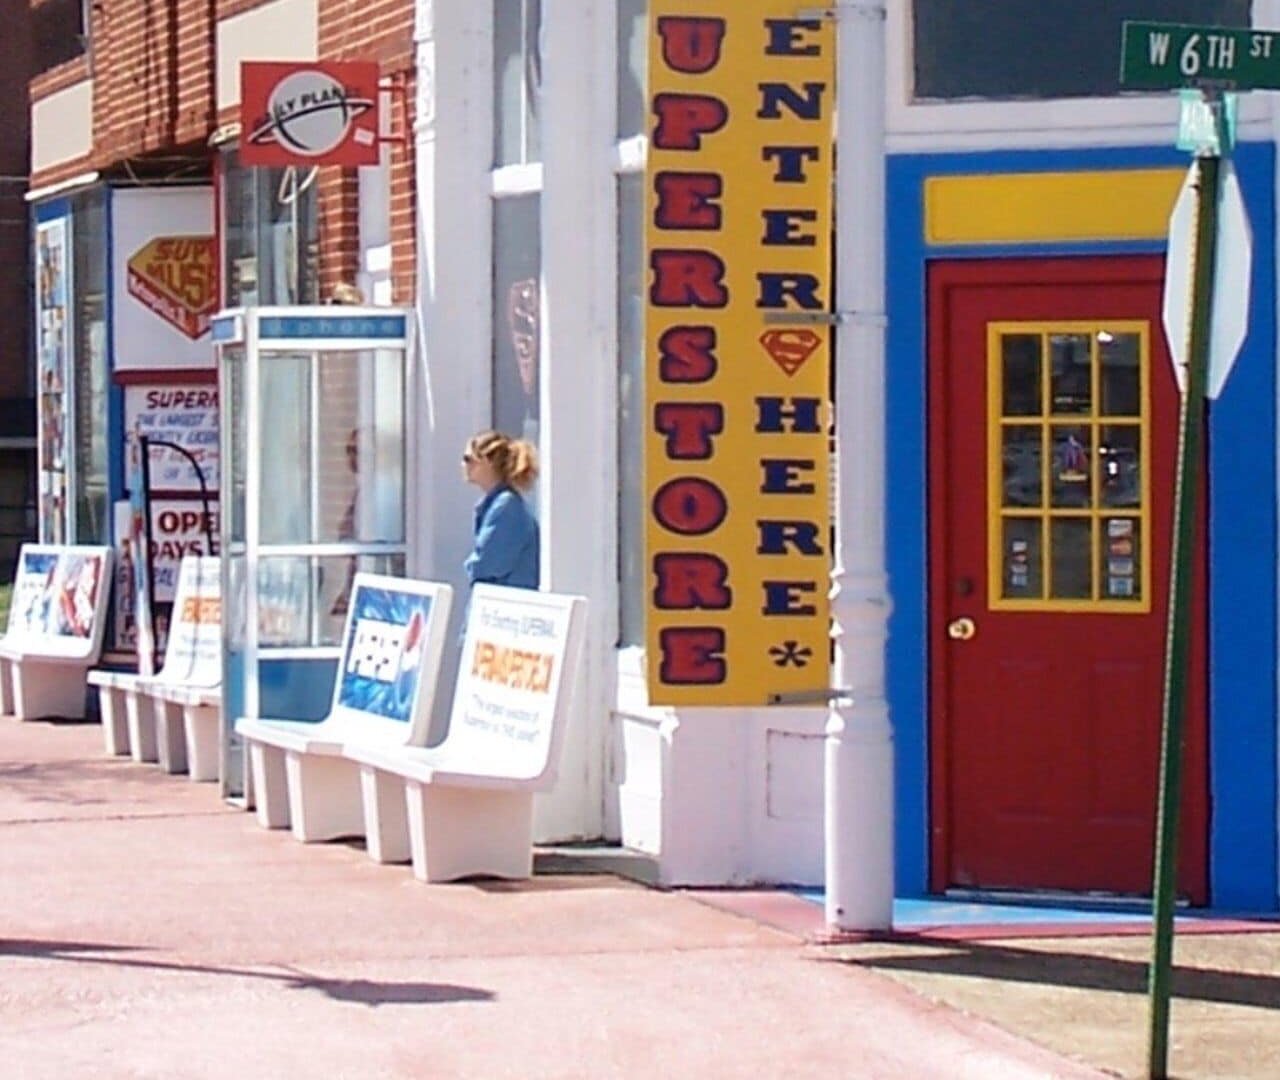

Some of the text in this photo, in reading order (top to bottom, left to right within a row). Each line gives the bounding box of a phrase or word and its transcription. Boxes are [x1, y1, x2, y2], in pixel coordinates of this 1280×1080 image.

[1149, 32, 1274, 76] W 6TH ST
[756, 19, 826, 309] ENTER
[153, 240, 214, 261] SUP
[158, 511, 220, 535] OPE
[754, 397, 823, 616] HERE
